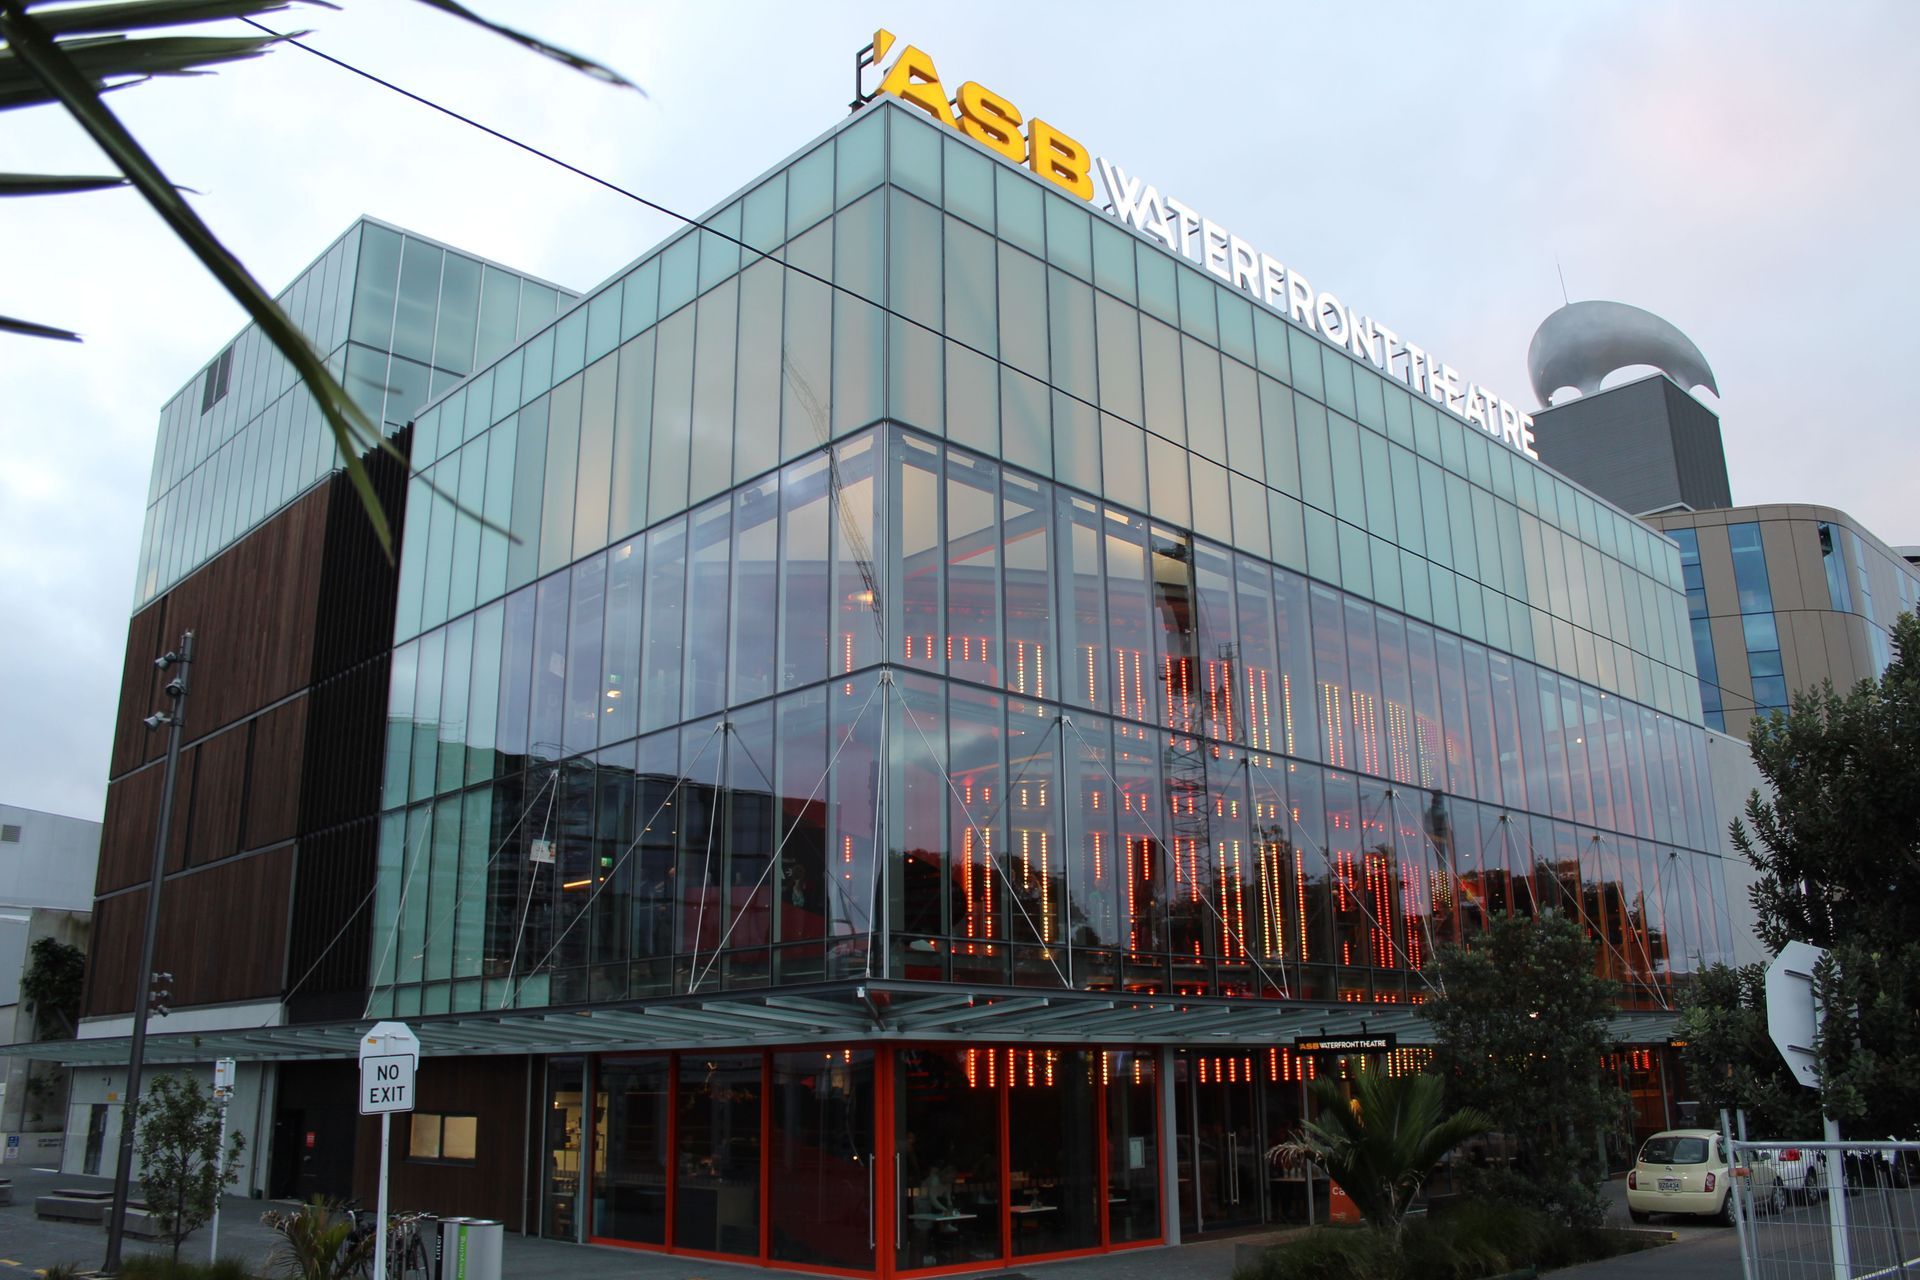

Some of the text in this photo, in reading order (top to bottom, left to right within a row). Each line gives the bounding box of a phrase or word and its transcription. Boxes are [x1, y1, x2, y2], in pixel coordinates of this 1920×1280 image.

[1096, 157, 1398, 377] WATERFRONT
[1402, 341, 1539, 461] THEATRE
[1319, 1040, 1359, 1049] WATERFRONT
[1360, 1040, 1386, 1048] THEATRE
[378, 1064, 399, 1080] NO
[370, 1085, 406, 1104] EXIT
